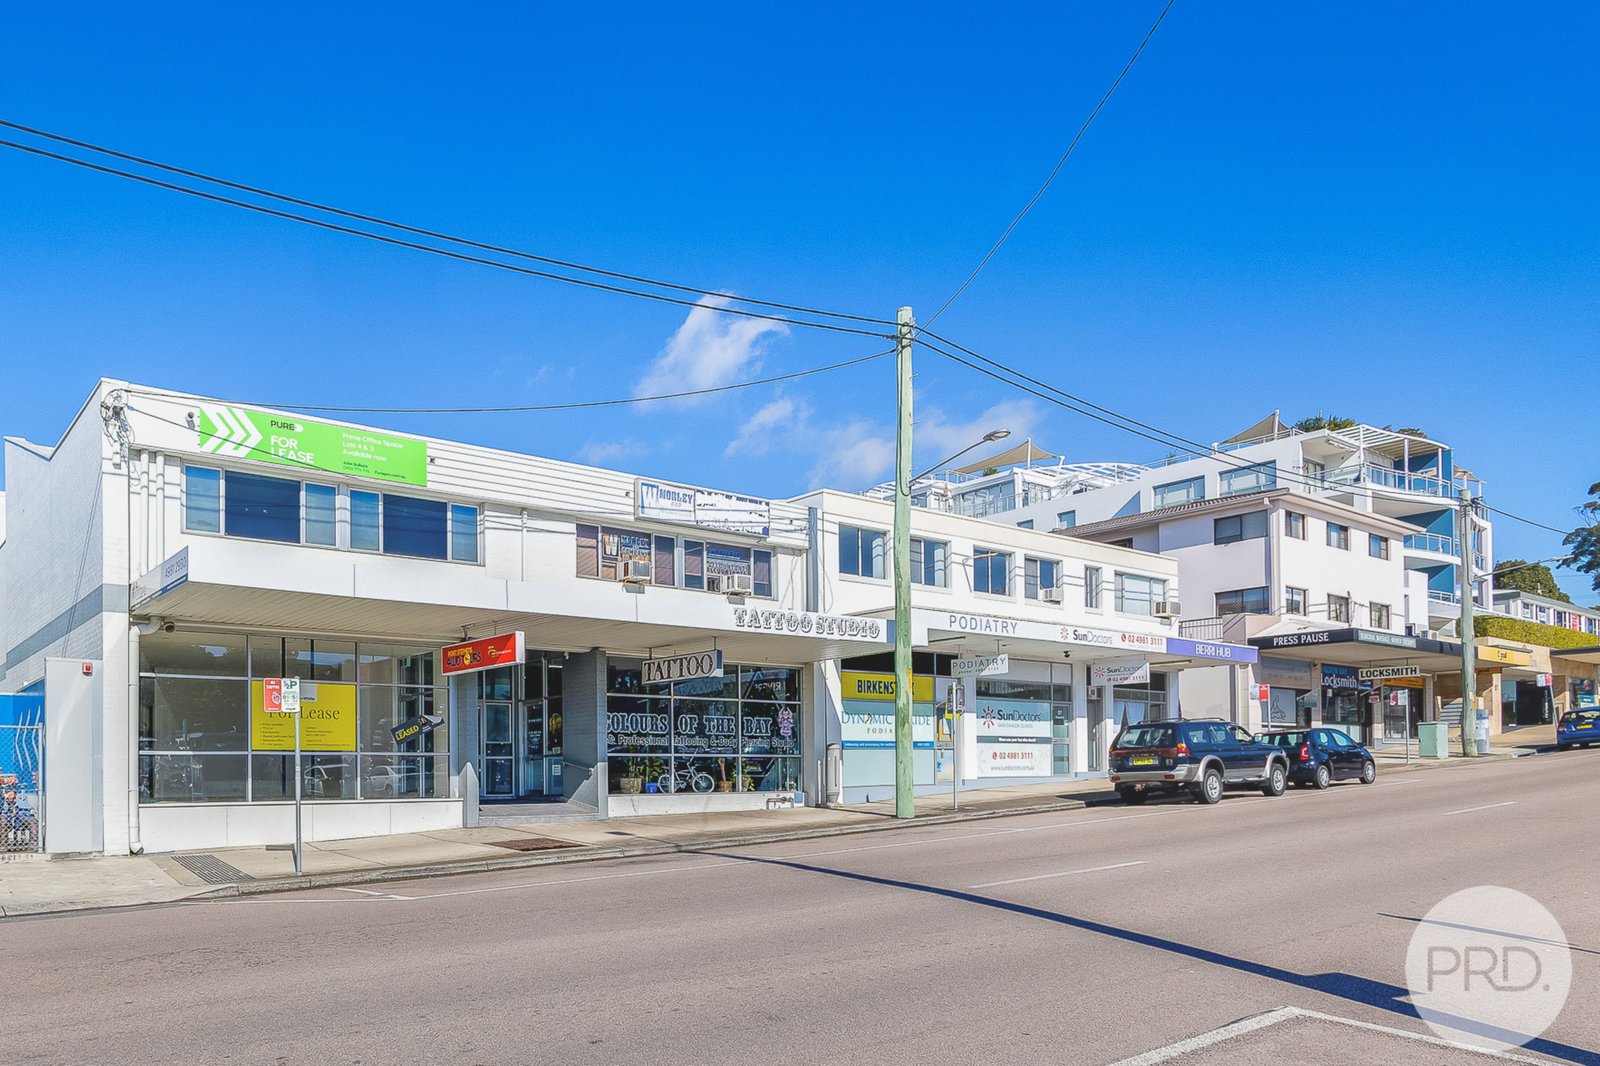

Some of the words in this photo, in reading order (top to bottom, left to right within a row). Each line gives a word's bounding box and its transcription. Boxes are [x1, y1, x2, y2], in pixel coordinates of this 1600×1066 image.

[270, 420, 295, 431] PURE
[270, 434, 298, 450] FOR
[271, 447, 315, 464] LEASE
[660, 488, 693, 505] MORLEY
[734, 607, 814, 634] TATTOO
[815, 614, 881, 639] STUDIO
[949, 614, 1018, 635] PODIATRY
[1072, 629, 1113, 645] SunDoctors
[1273, 635, 1299, 646] PRESS
[1301, 632, 1330, 643] PAUSE
[1195, 644, 1215, 656] BERRI
[1216, 646, 1231, 658] HUB
[643, 653, 714, 682] TATTOO
[952, 657, 1007, 670] PODIATRY
[1106, 665, 1146, 674] SunDoctor
[1360, 666, 1418, 679] LOCKSMITH
[1320, 673, 1358, 689] Locksmith
[301, 705, 341, 720] Lease
[997, 709, 1041, 722] SunDoctors
[394, 724, 420, 741] LEASED
[678, 714, 699, 734] OF
[703, 715, 736, 735] THE
[742, 717, 772, 736] BAY
[618, 734, 670, 747] Professional
[999, 752, 1006, 760] 02
[1007, 752, 1020, 760] 4981
